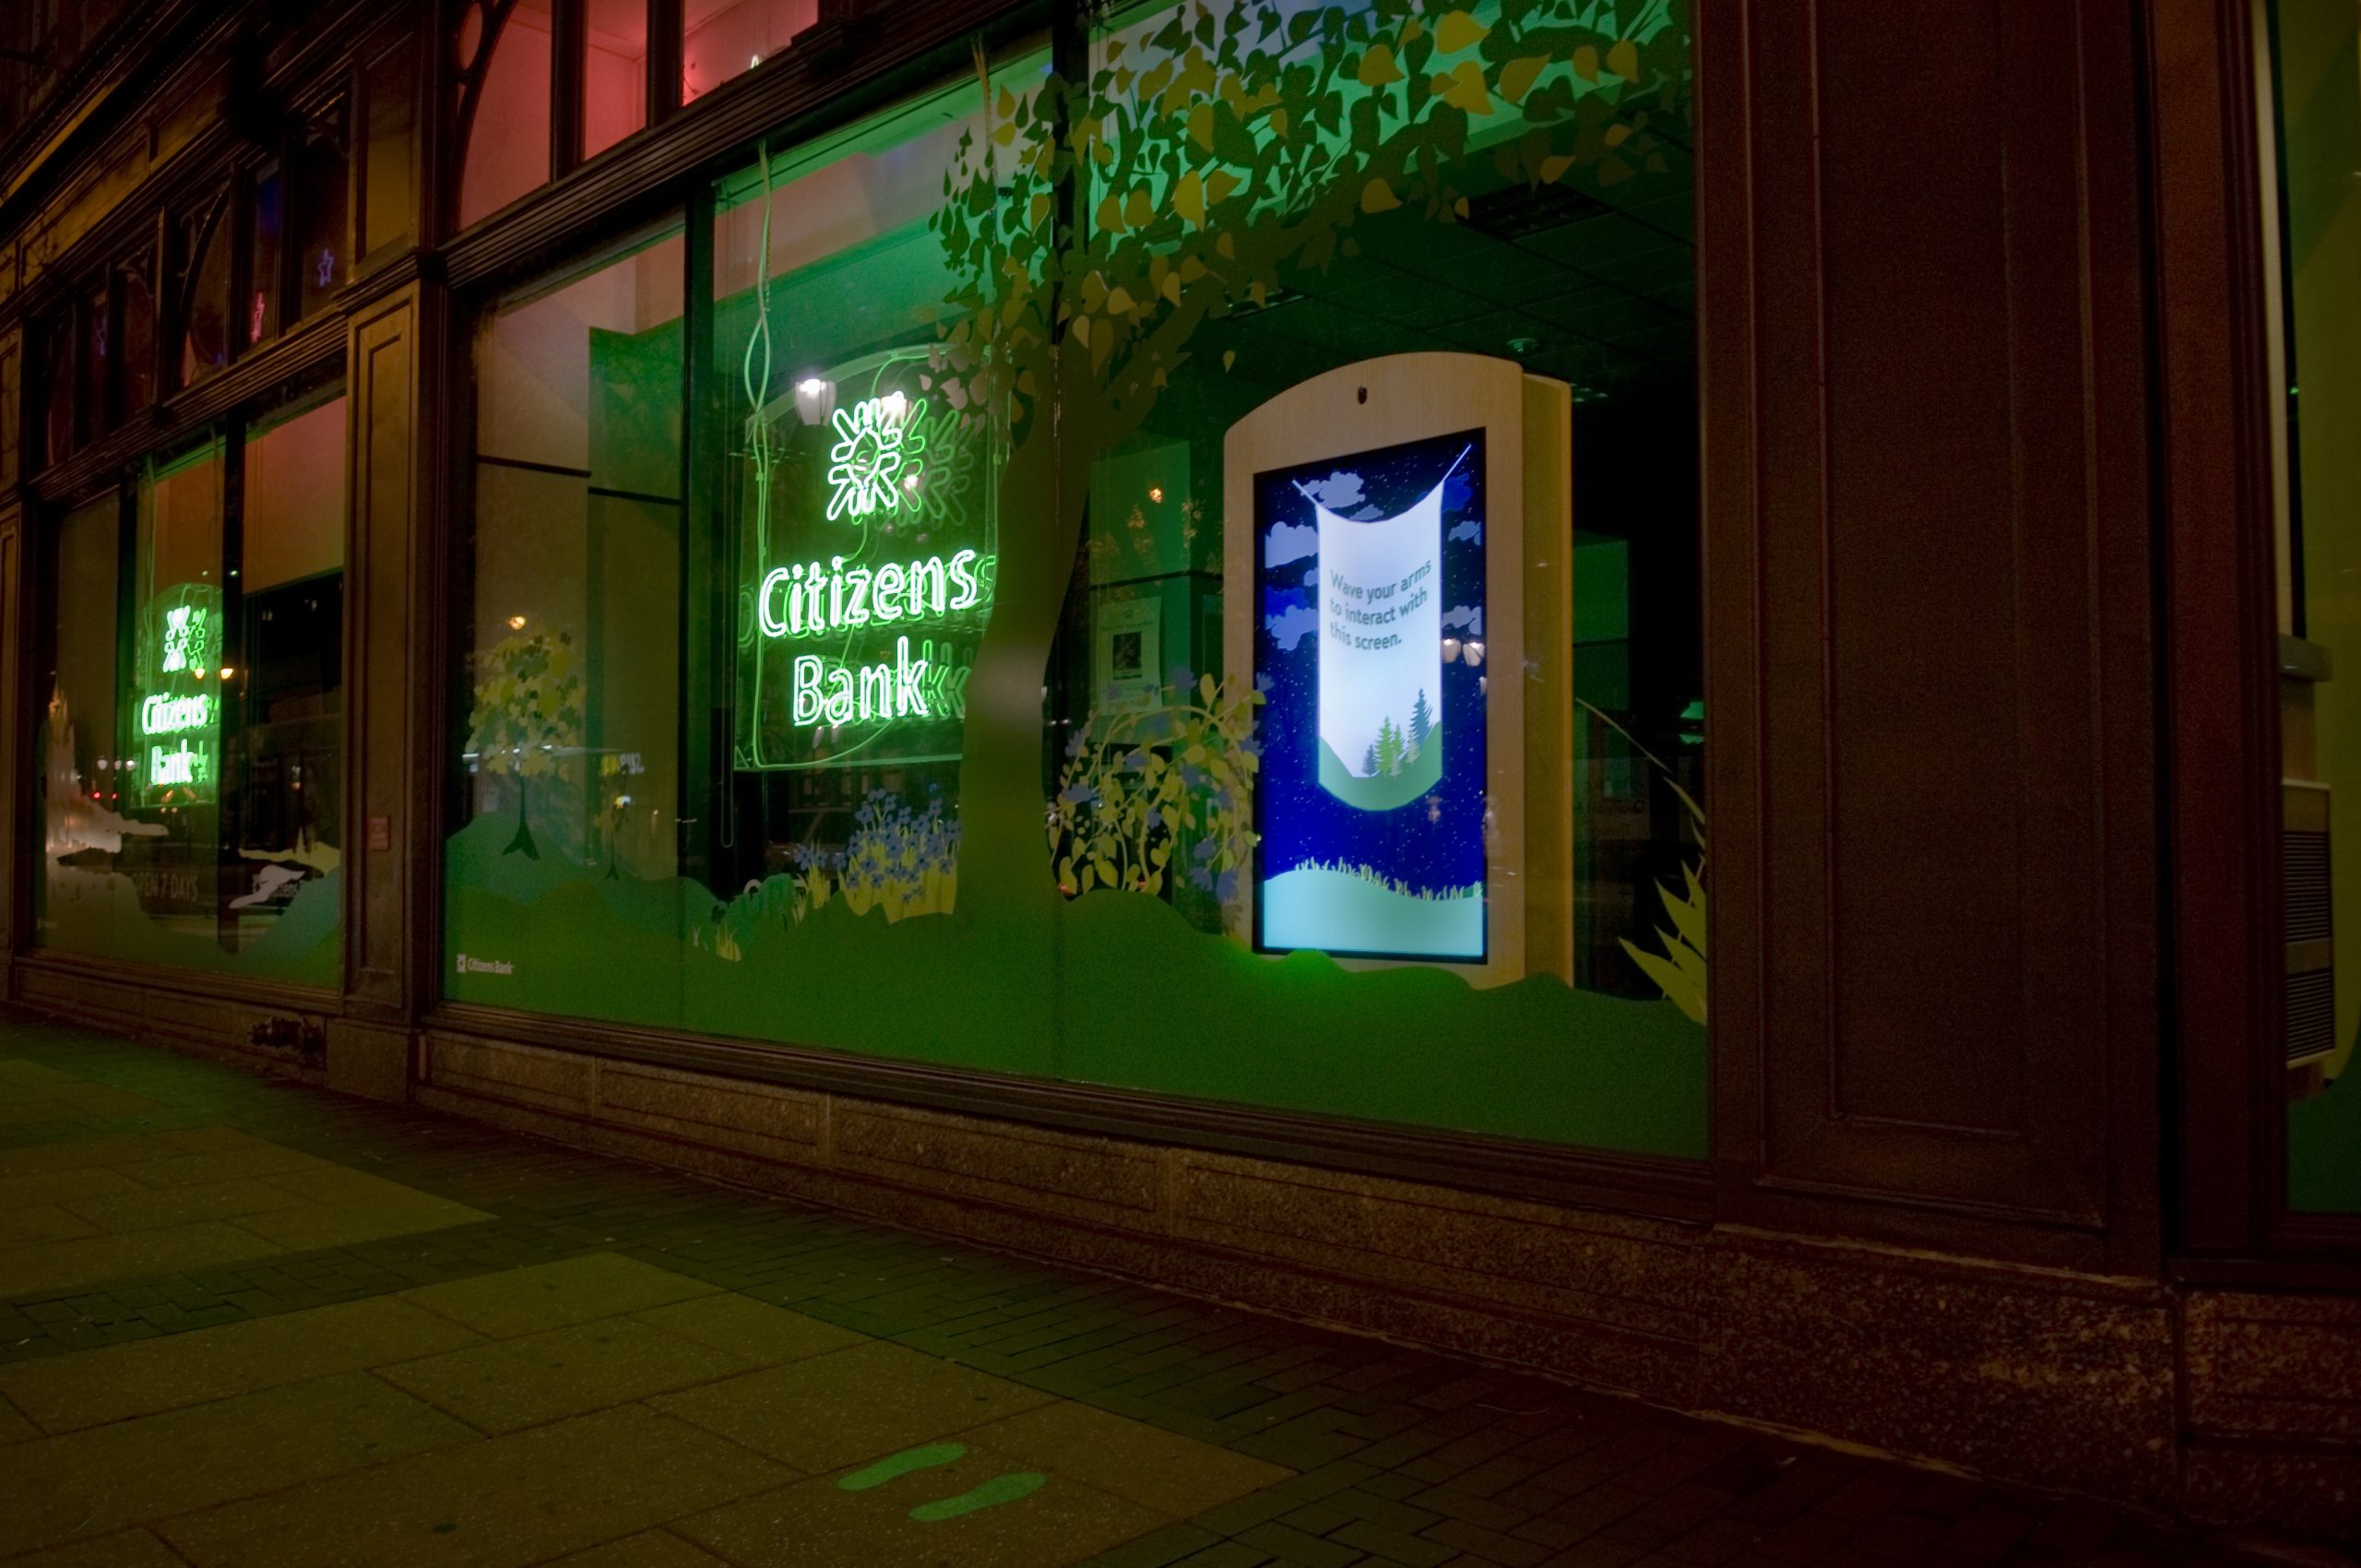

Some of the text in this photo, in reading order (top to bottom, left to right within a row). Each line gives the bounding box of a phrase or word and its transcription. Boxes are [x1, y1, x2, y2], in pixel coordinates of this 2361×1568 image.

[758, 549, 978, 638] Citizens
[1330, 559, 1432, 605] Wave your arms
[1330, 587, 1428, 625] to interact with
[1330, 621, 1403, 650] this screen.
[793, 636, 929, 726] Bank
[141, 692, 208, 735] Citizens
[150, 738, 194, 785] Bank
[468, 958, 494, 973] Citizens
